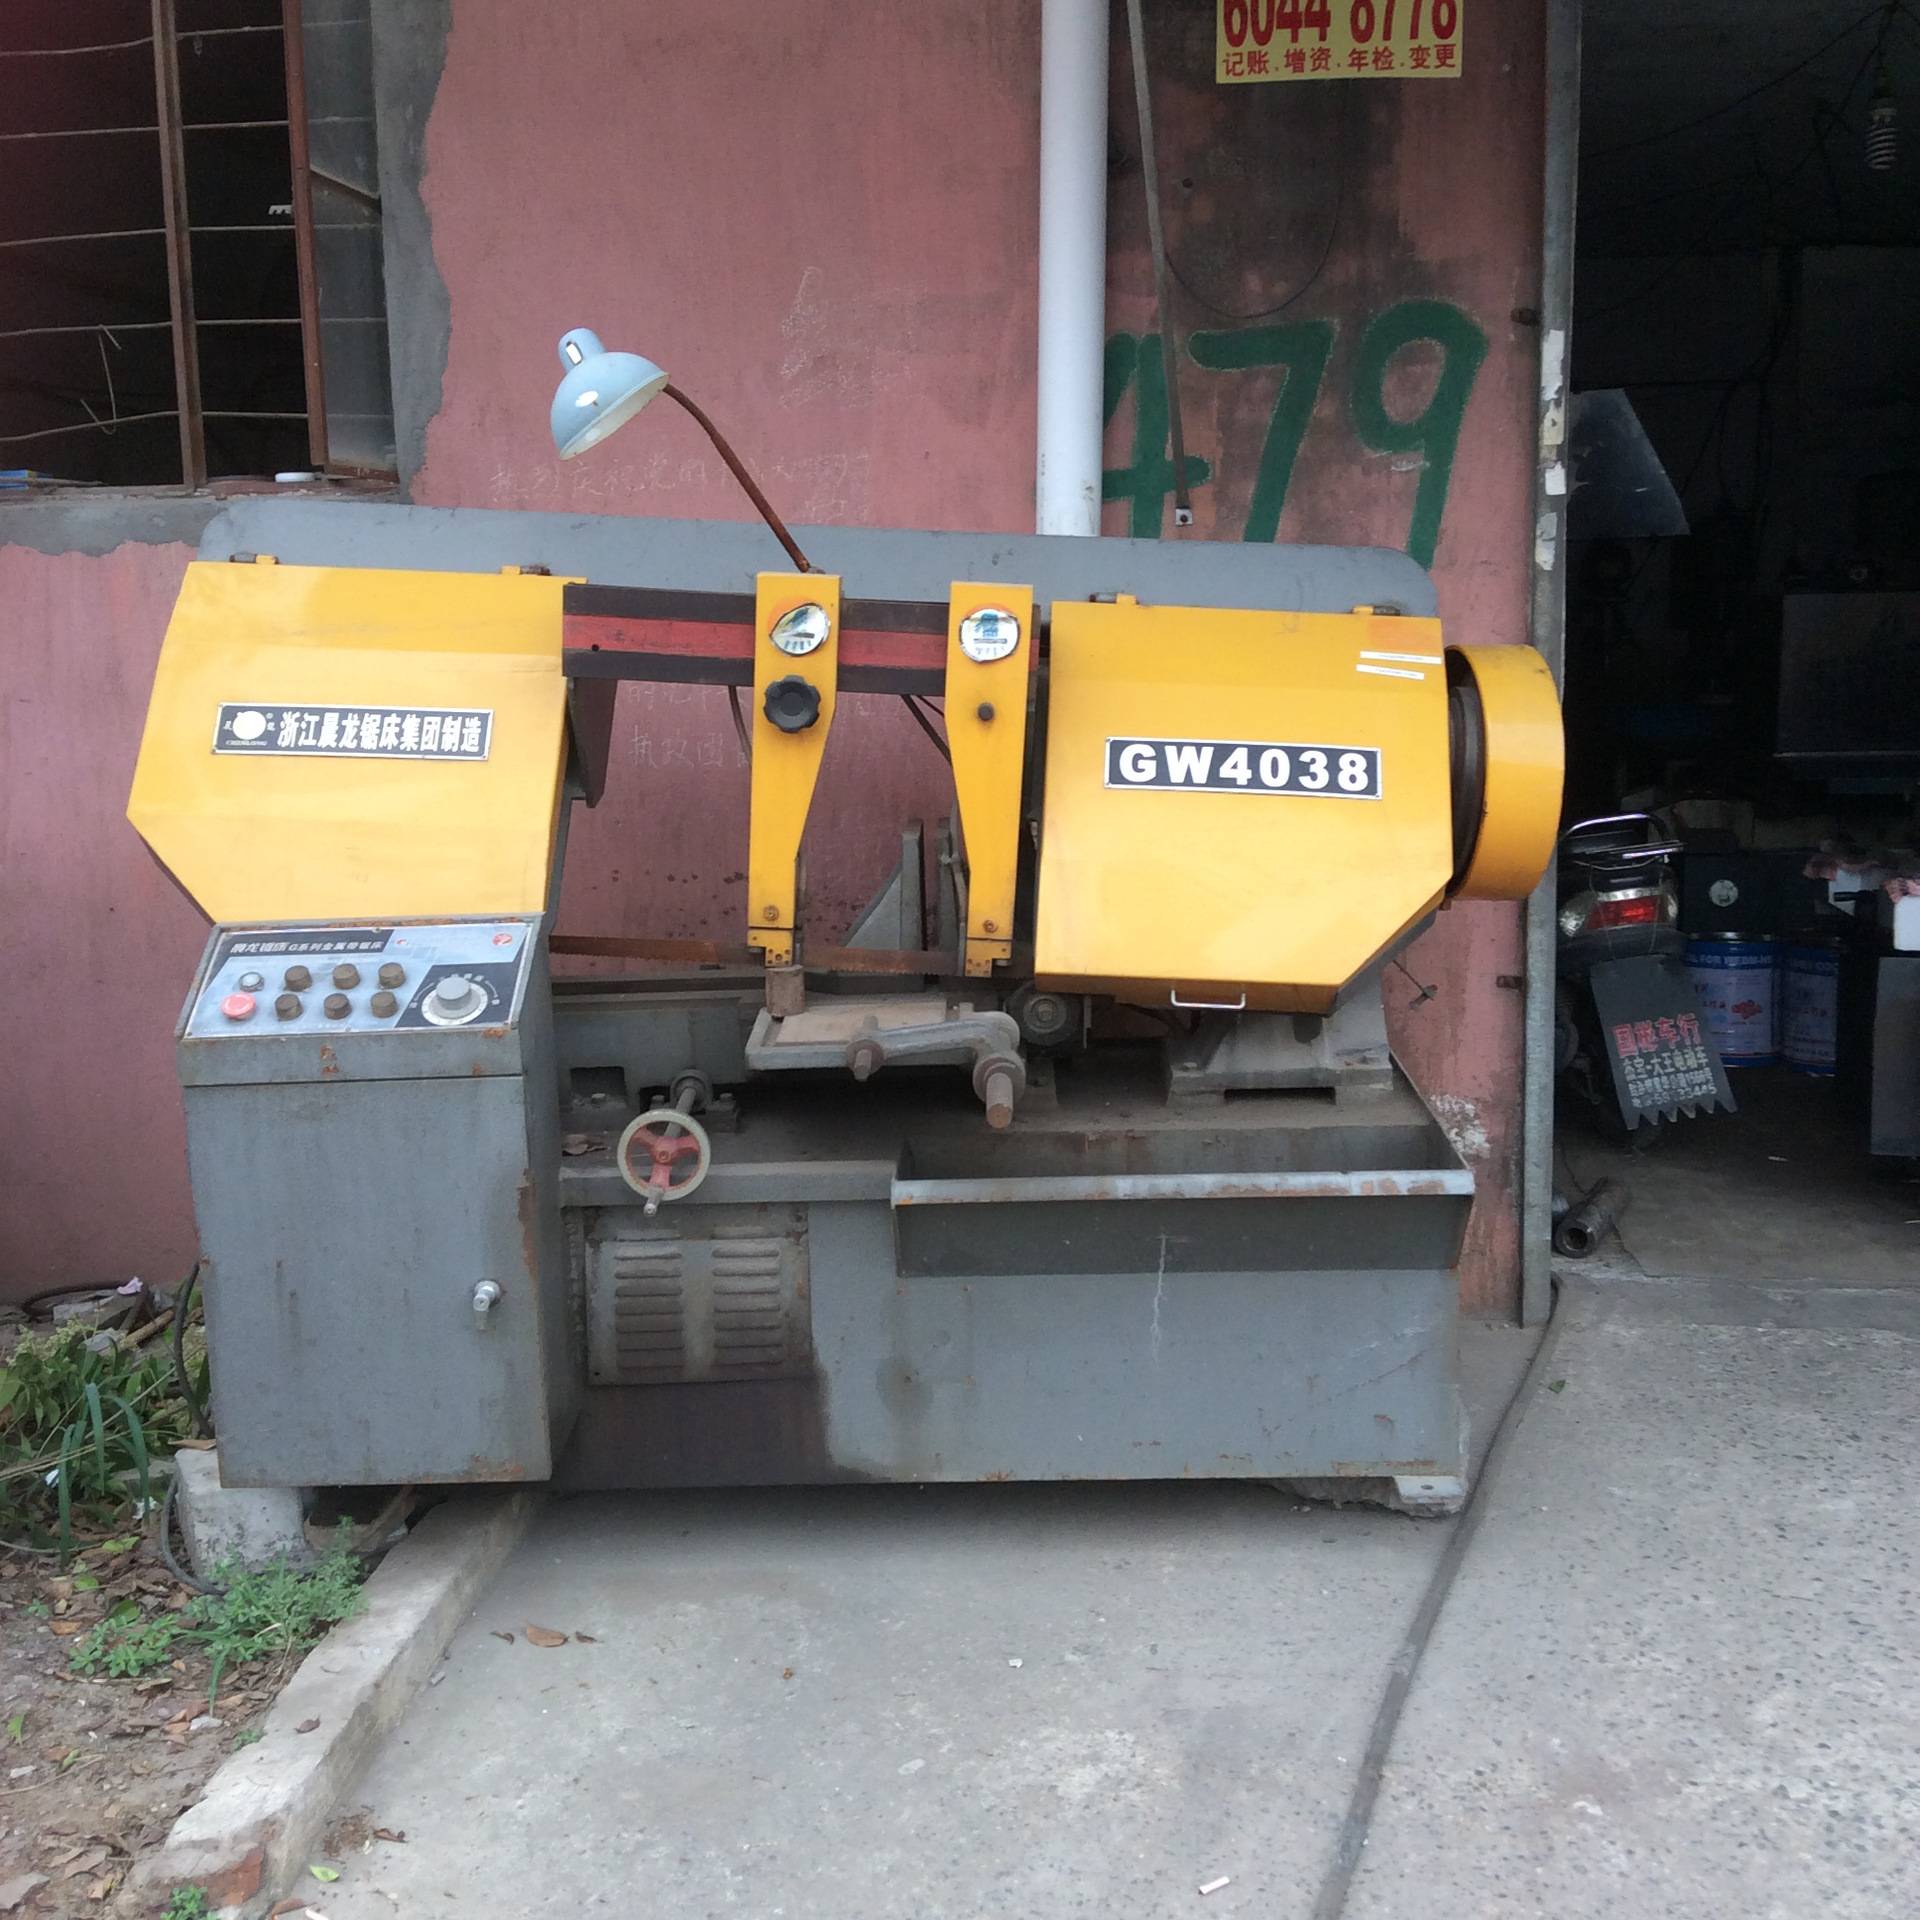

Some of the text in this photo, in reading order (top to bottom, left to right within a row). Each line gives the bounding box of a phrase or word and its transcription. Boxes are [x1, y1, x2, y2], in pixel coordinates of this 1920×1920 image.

[277, 710, 481, 753] 浙江晨龙锯床集团制造
[1119, 743, 1369, 792] GW4038
